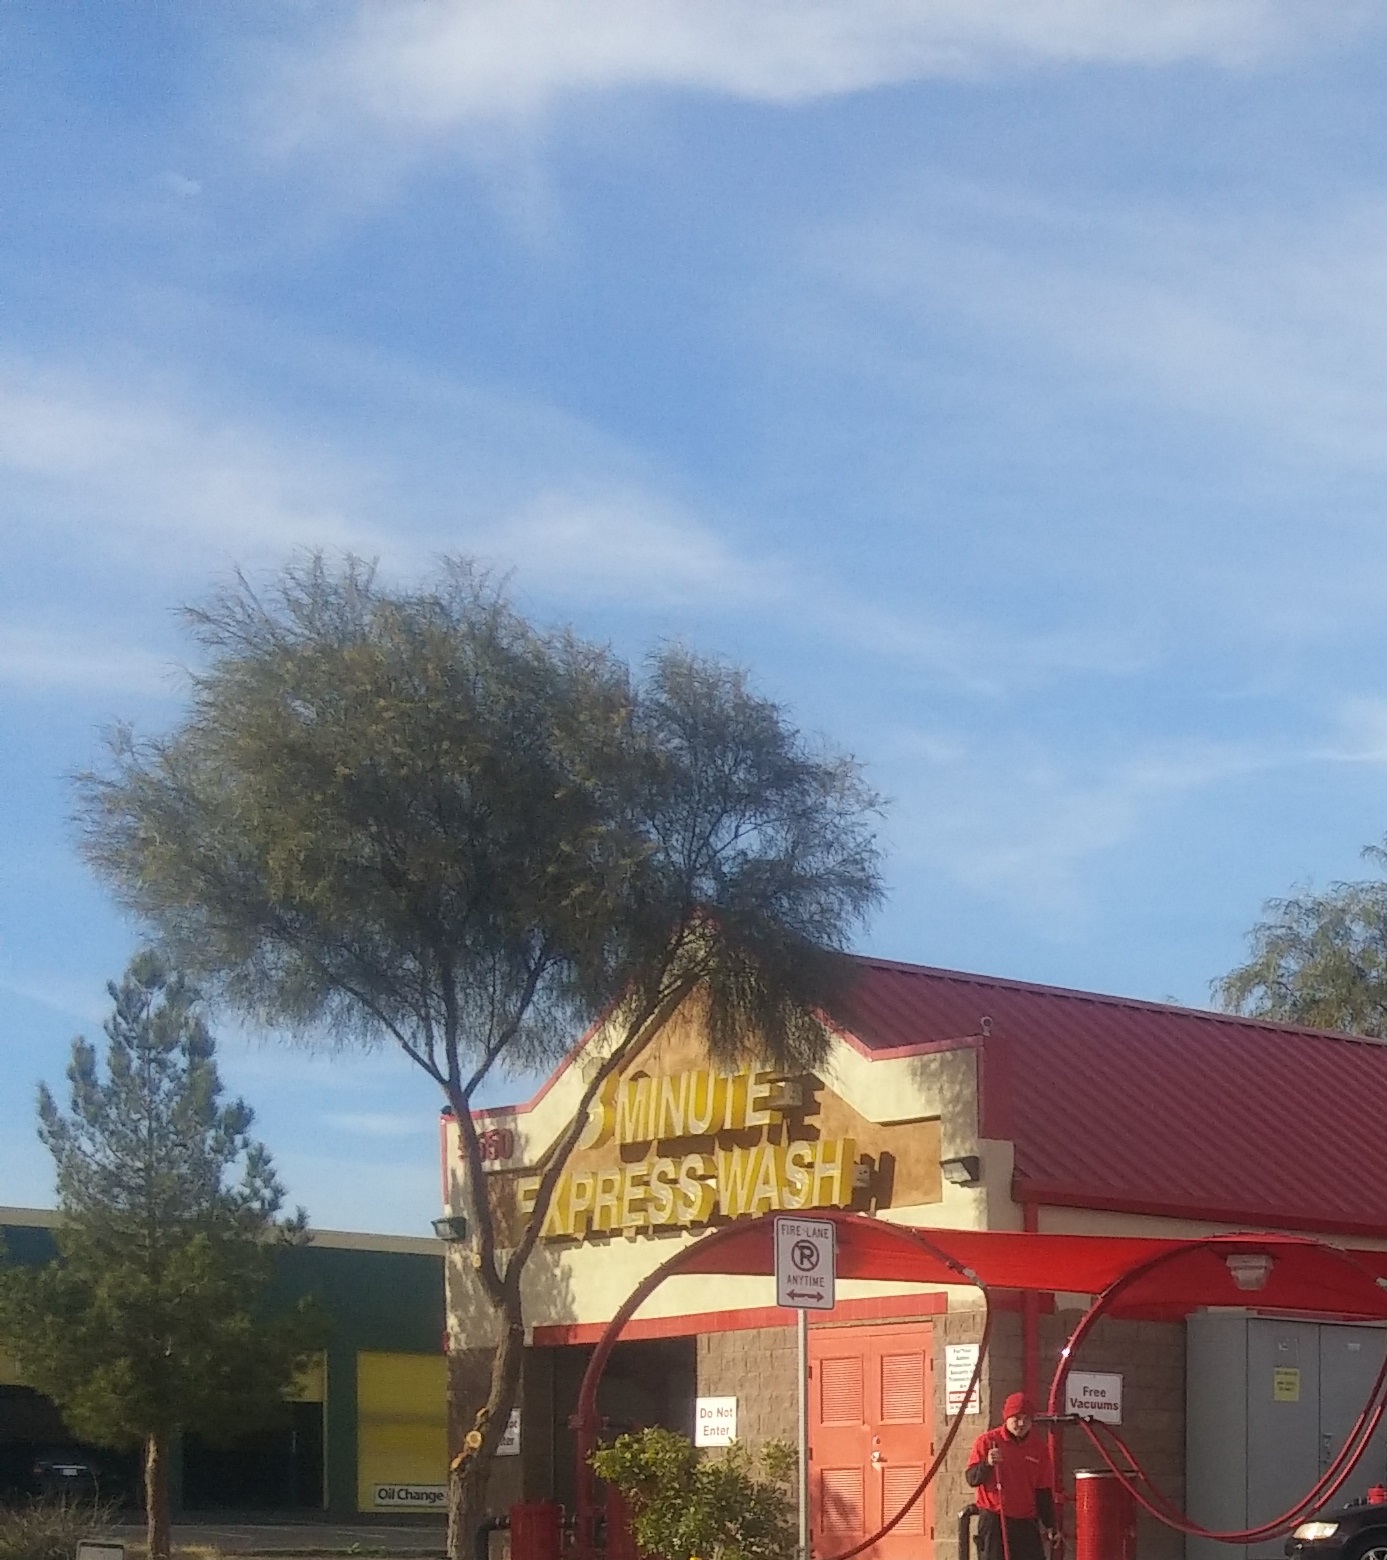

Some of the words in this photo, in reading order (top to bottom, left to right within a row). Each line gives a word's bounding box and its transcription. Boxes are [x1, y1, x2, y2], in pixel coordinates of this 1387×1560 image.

[615, 1064, 778, 1144] MINUTE
[517, 1153, 711, 1237] EXPRESS
[717, 1138, 852, 1216] WASH
[781, 1224, 802, 1237] FIRE
[806, 1227, 830, 1239] LANE
[787, 1275, 825, 1287] ANYTIME
[1082, 1386, 1106, 1397] Free
[1070, 1398, 1119, 1411] Vacuums
[700, 1408, 713, 1418] Do
[716, 1407, 733, 1418] Not
[703, 1425, 730, 1436] Enter
[378, 1488, 395, 1500] Oil
[397, 1488, 444, 1504] Change
